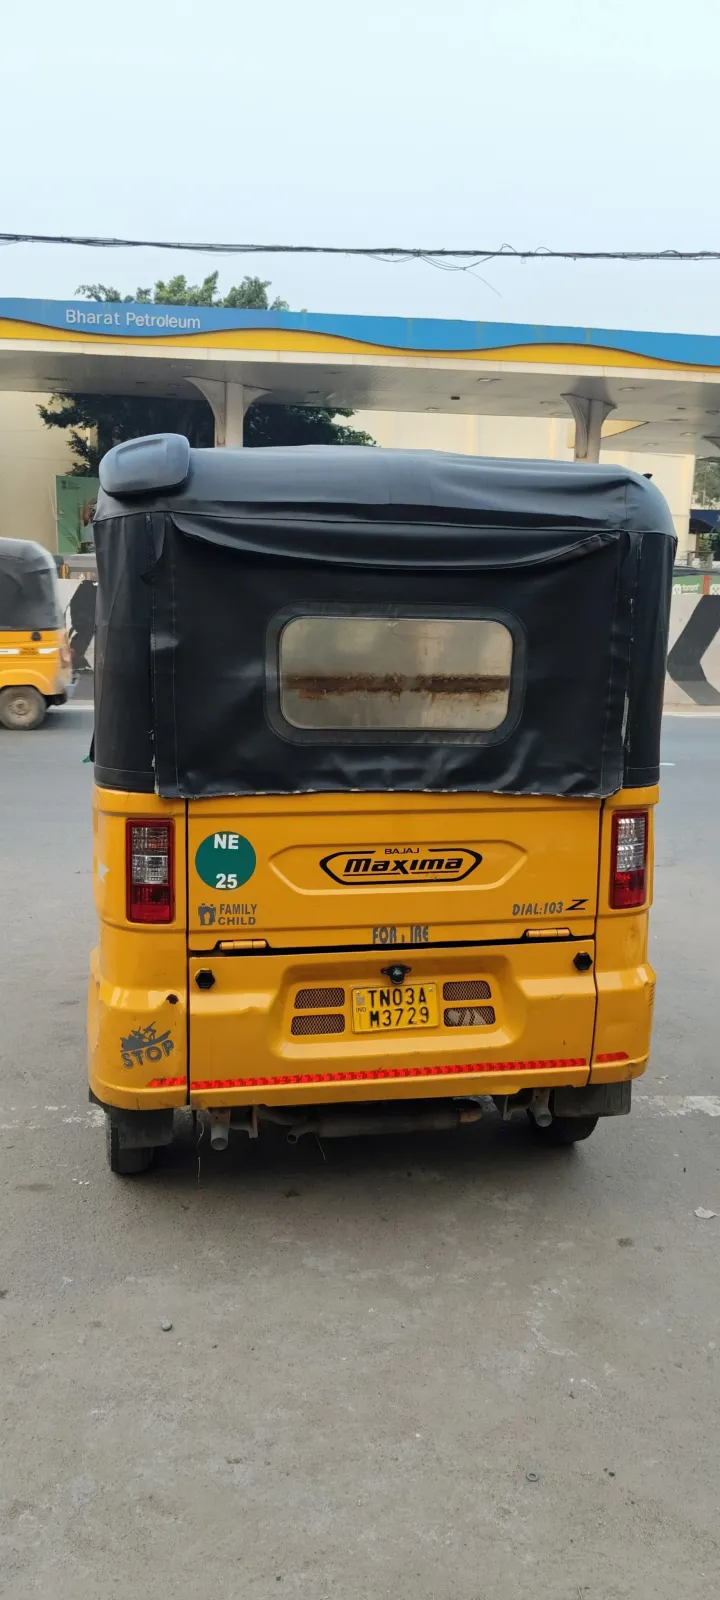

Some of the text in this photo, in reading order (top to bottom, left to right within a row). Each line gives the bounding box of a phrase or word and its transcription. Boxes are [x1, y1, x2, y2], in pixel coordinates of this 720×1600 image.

[65, 309, 201, 329] Bharat Petroleum
[213, 833, 240, 850] NE
[384, 847, 420, 855] BAJAJ
[344, 858, 463, 875] Maxima
[215, 873, 238, 889] 25
[219, 903, 257, 915] FAMILY
[512, 901, 564, 916] DIAL:103
[218, 916, 256, 926] CHILD
[372, 926, 397, 945] FOR
[367, 987, 427, 1008] TN03A
[369, 1006, 430, 1027] M3729
[120, 1038, 175, 1070] STOP
